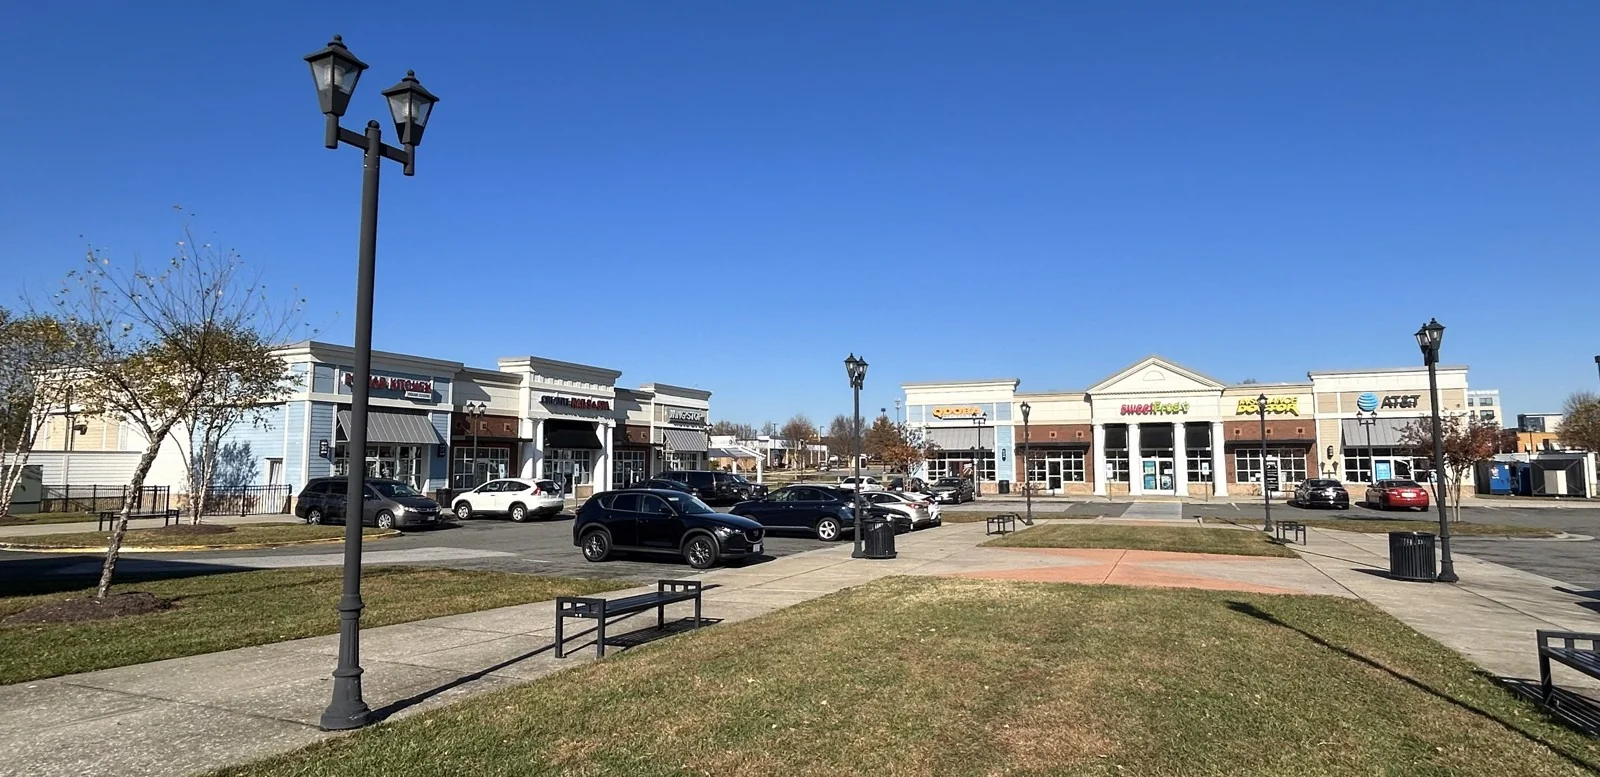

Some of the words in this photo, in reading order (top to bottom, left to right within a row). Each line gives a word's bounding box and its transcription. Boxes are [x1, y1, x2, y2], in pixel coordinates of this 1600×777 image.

[389, 377, 433, 394] KITCHEN
[570, 397, 593, 409] NAILS
[1381, 395, 1421, 409] AT&T
[932, 406, 982, 419] QDOBA
